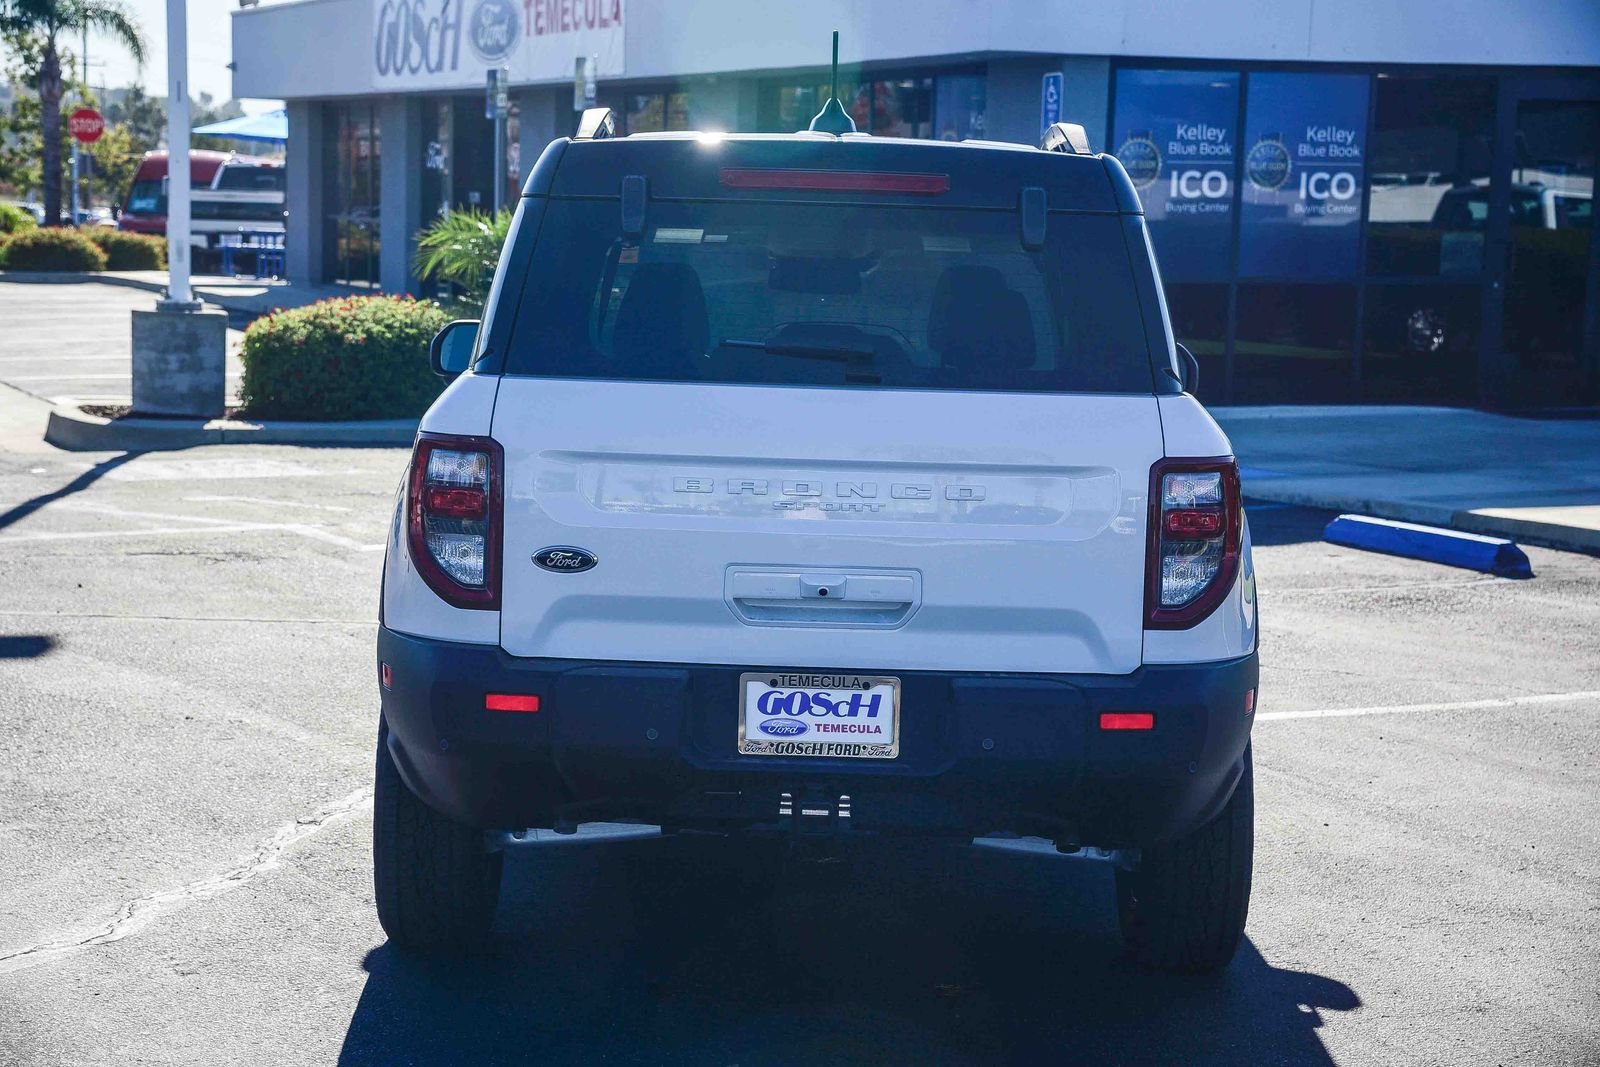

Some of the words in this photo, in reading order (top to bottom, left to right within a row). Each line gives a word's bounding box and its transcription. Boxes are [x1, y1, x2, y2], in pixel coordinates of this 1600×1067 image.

[478, 3, 510, 47] Ford
[523, 0, 622, 36] TEMECULA
[71, 118, 103, 133] STOP
[1176, 124, 1226, 142] Kelley
[1306, 126, 1355, 144] Kelley
[1168, 141, 1197, 155] Blue
[1200, 142, 1232, 155] Book
[1298, 144, 1327, 157] Blue
[1329, 144, 1360, 157] Book
[1170, 170, 1228, 199] ICO
[1300, 172, 1356, 200] ICO
[1166, 202, 1197, 213] Buying
[1198, 202, 1229, 212] Center
[1294, 203, 1326, 215] Buying
[1327, 203, 1357, 214] Center
[673, 476, 986, 501] BRONCO
[772, 501, 886, 513] SPORT
[546, 551, 582, 567] Ford
[779, 675, 862, 688] TEMECULA
[767, 721, 799, 734] Ford
[815, 723, 882, 734] TEMECULA
[744, 743, 769, 753] Ford
[826, 743, 861, 756] FORD
[867, 746, 892, 756] Ford
